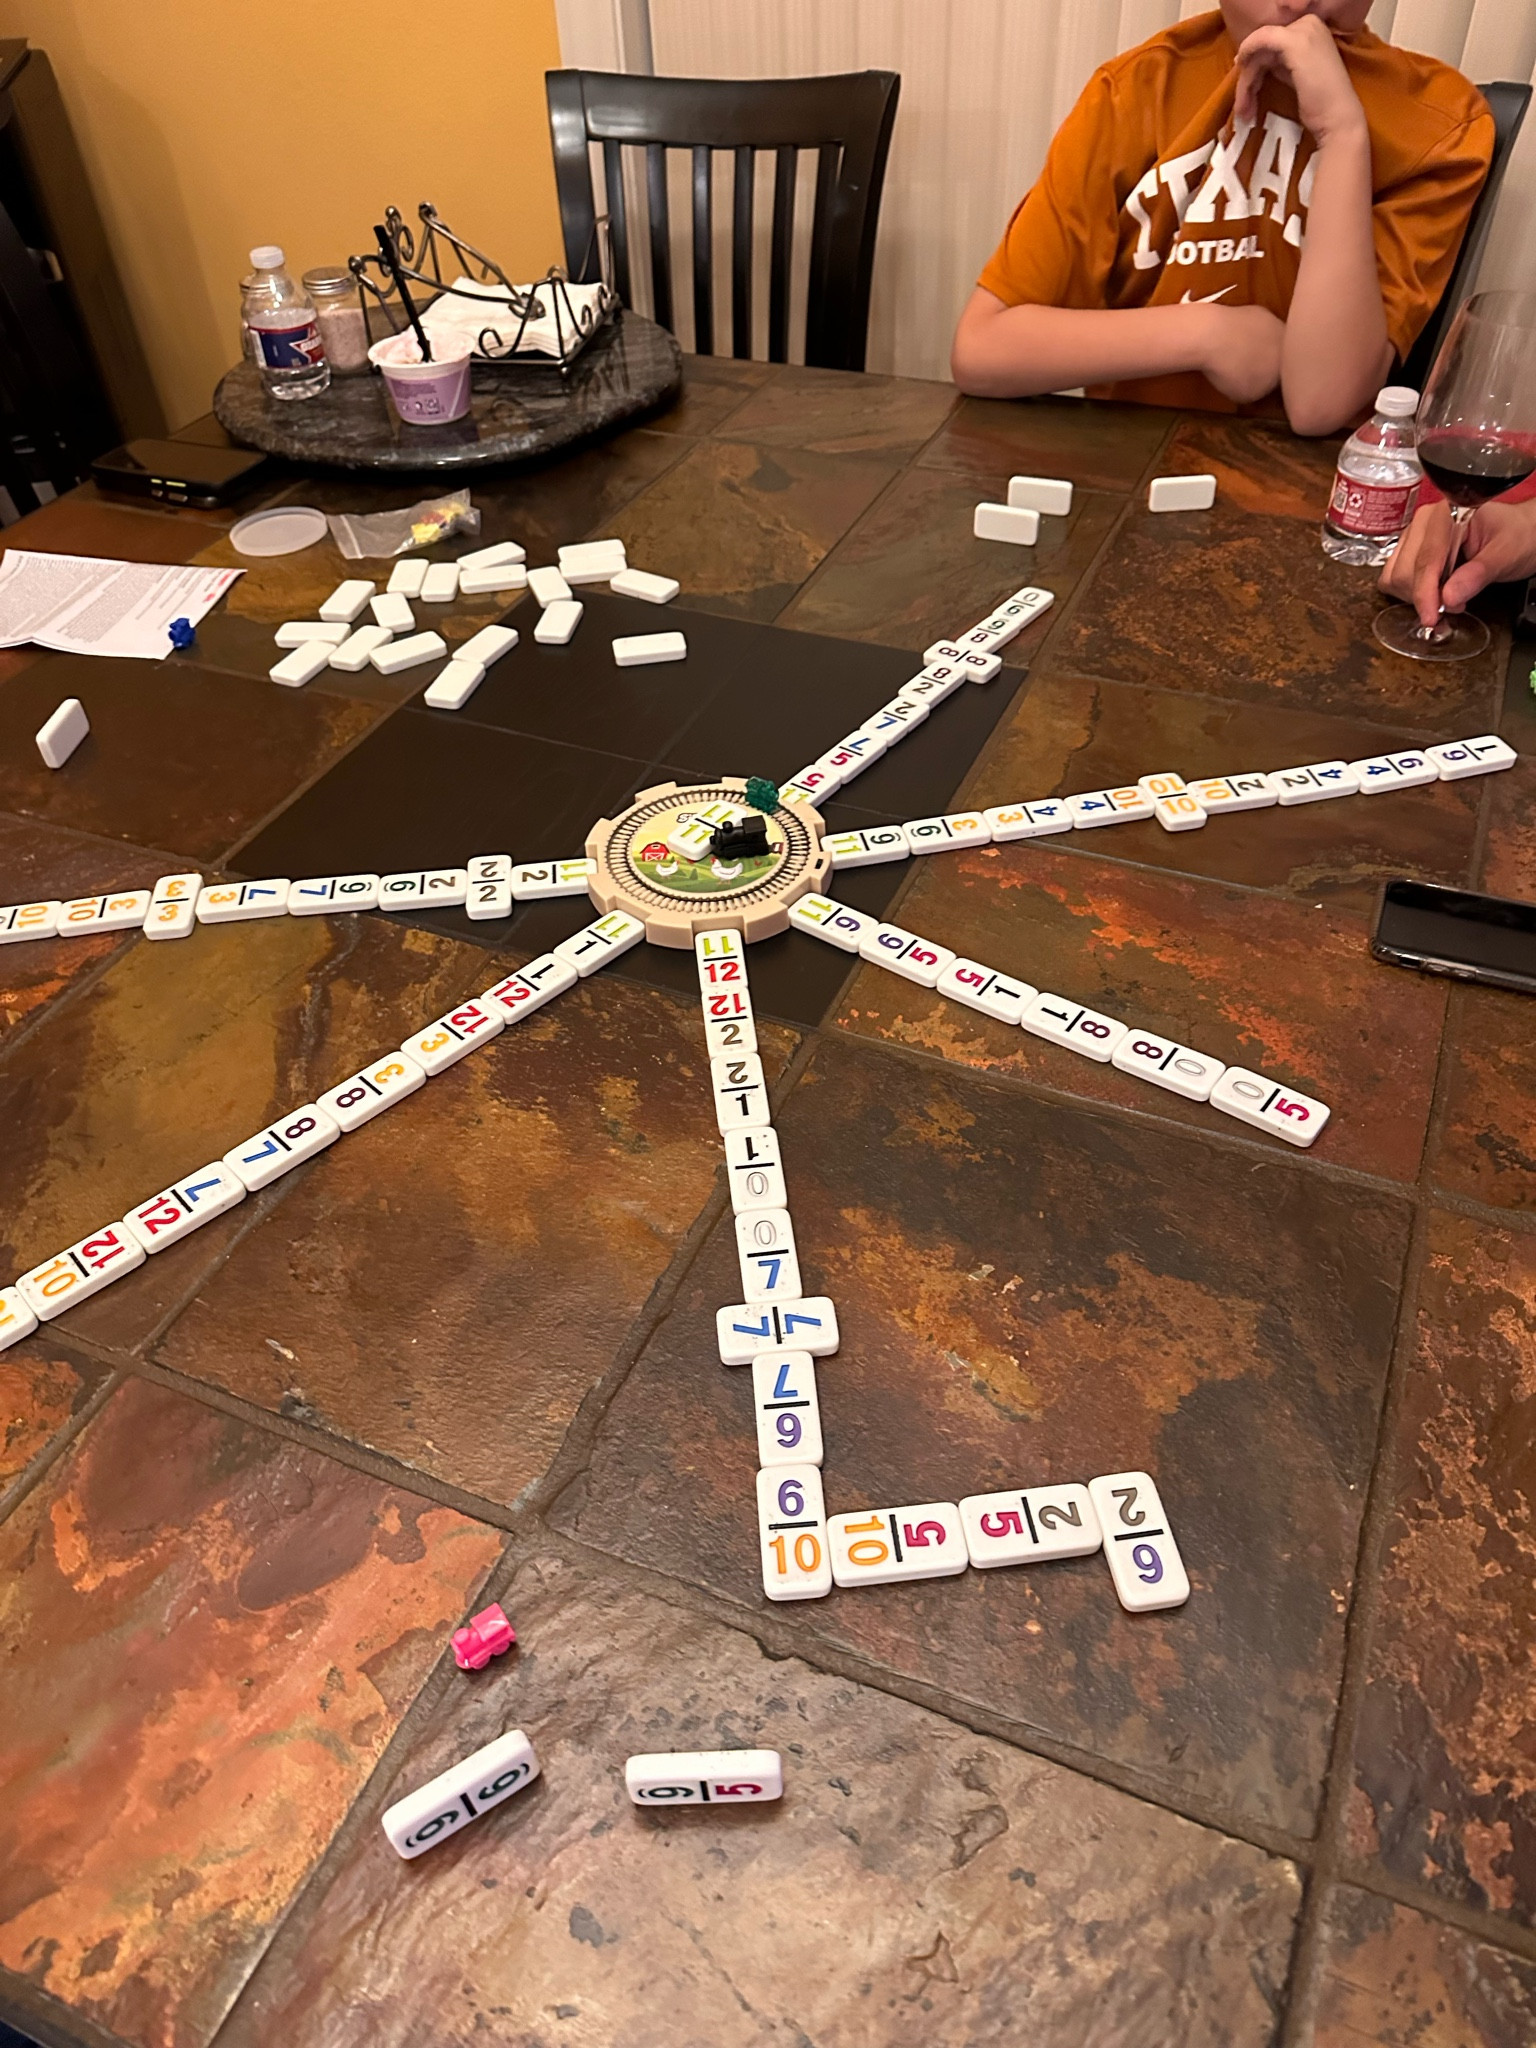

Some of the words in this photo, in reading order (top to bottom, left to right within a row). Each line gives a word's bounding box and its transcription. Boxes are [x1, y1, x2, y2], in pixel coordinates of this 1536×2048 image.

[970, 633, 988, 643] 8
[938, 647, 959, 657] 8
[966, 656, 987, 666] 8
[933, 668, 952, 679] 8
[913, 682, 934, 694] 2
[895, 702, 916, 714] 2
[876, 717, 898, 729] 7
[850, 738, 871, 750] 7
[1476, 744, 1498, 753] 1
[830, 752, 853, 766] 5
[801, 773, 824, 786] 5
[1318, 769, 1344, 779] 4
[1366, 765, 1390, 776] 4
[1148, 777, 1183, 794] 10
[1200, 780, 1231, 800] 10
[1238, 779, 1265, 791] 2
[1284, 774, 1309, 787] 2
[1080, 800, 1105, 810] 4
[1112, 790, 1141, 810] 10
[1161, 798, 1197, 814] 10
[702, 804, 734, 823] 11
[998, 811, 1023, 823] 3
[1034, 806, 1058, 816] 4
[680, 824, 713, 844] 11
[952, 819, 978, 831] 3
[832, 835, 862, 854] 11
[480, 862, 498, 878] 2
[522, 870, 548, 882] 2
[560, 862, 587, 881] 11
[166, 880, 186, 896] 3
[300, 884, 327, 896] 7
[429, 876, 455, 888] 2
[209, 892, 236, 904] 3
[248, 889, 276, 900] 7
[479, 885, 496, 902] 2
[68, 900, 98, 921] 10
[109, 898, 136, 910] 3
[158, 904, 179, 922] 3
[798, 900, 831, 921] 11
[18, 906, 48, 928] 10
[595, 916, 630, 938] 11
[574, 940, 598, 956] 1
[703, 936, 734, 956] 11
[909, 947, 938, 966] 5
[531, 964, 554, 980] 1
[704, 962, 740, 982] 12
[956, 968, 985, 988] 5
[493, 980, 530, 1008] 12
[994, 985, 1021, 998] 1
[708, 993, 746, 1016] 12
[1040, 1007, 1068, 1021] 1
[451, 1005, 489, 1034] 12
[1080, 1020, 1110, 1038] 8
[420, 1032, 449, 1052] 3
[721, 1024, 743, 1046] 2
[1132, 1040, 1163, 1059] 8
[374, 1064, 404, 1084] 3
[726, 1062, 748, 1084] 2
[1174, 1058, 1206, 1076] 0
[336, 1087, 366, 1108] 8
[1232, 1081, 1264, 1099] 0
[736, 1094, 750, 1116] 1
[1274, 1098, 1310, 1121] 5
[285, 1117, 316, 1138] 8
[242, 1140, 278, 1163] 7
[745, 1136, 759, 1160] 1
[184, 1178, 221, 1202] 7
[746, 1171, 770, 1198] 0
[138, 1197, 180, 1235] 12
[754, 1220, 776, 1248] 0
[82, 1230, 125, 1269] 12
[34, 1260, 76, 1297] 10
[758, 1259, 781, 1290] 7
[732, 1316, 770, 1336] 7
[784, 1313, 822, 1334] 7
[773, 1364, 798, 1398] 7
[776, 1412, 802, 1448] 9
[1038, 1501, 1082, 1531] 2
[1112, 1487, 1146, 1526] 2
[980, 1510, 1024, 1538] 5
[844, 1515, 889, 1566] 10
[904, 1520, 946, 1548] 5
[768, 1533, 822, 1574] 10
[1132, 1544, 1164, 1584] 9
[714, 1783, 762, 1796] 5
